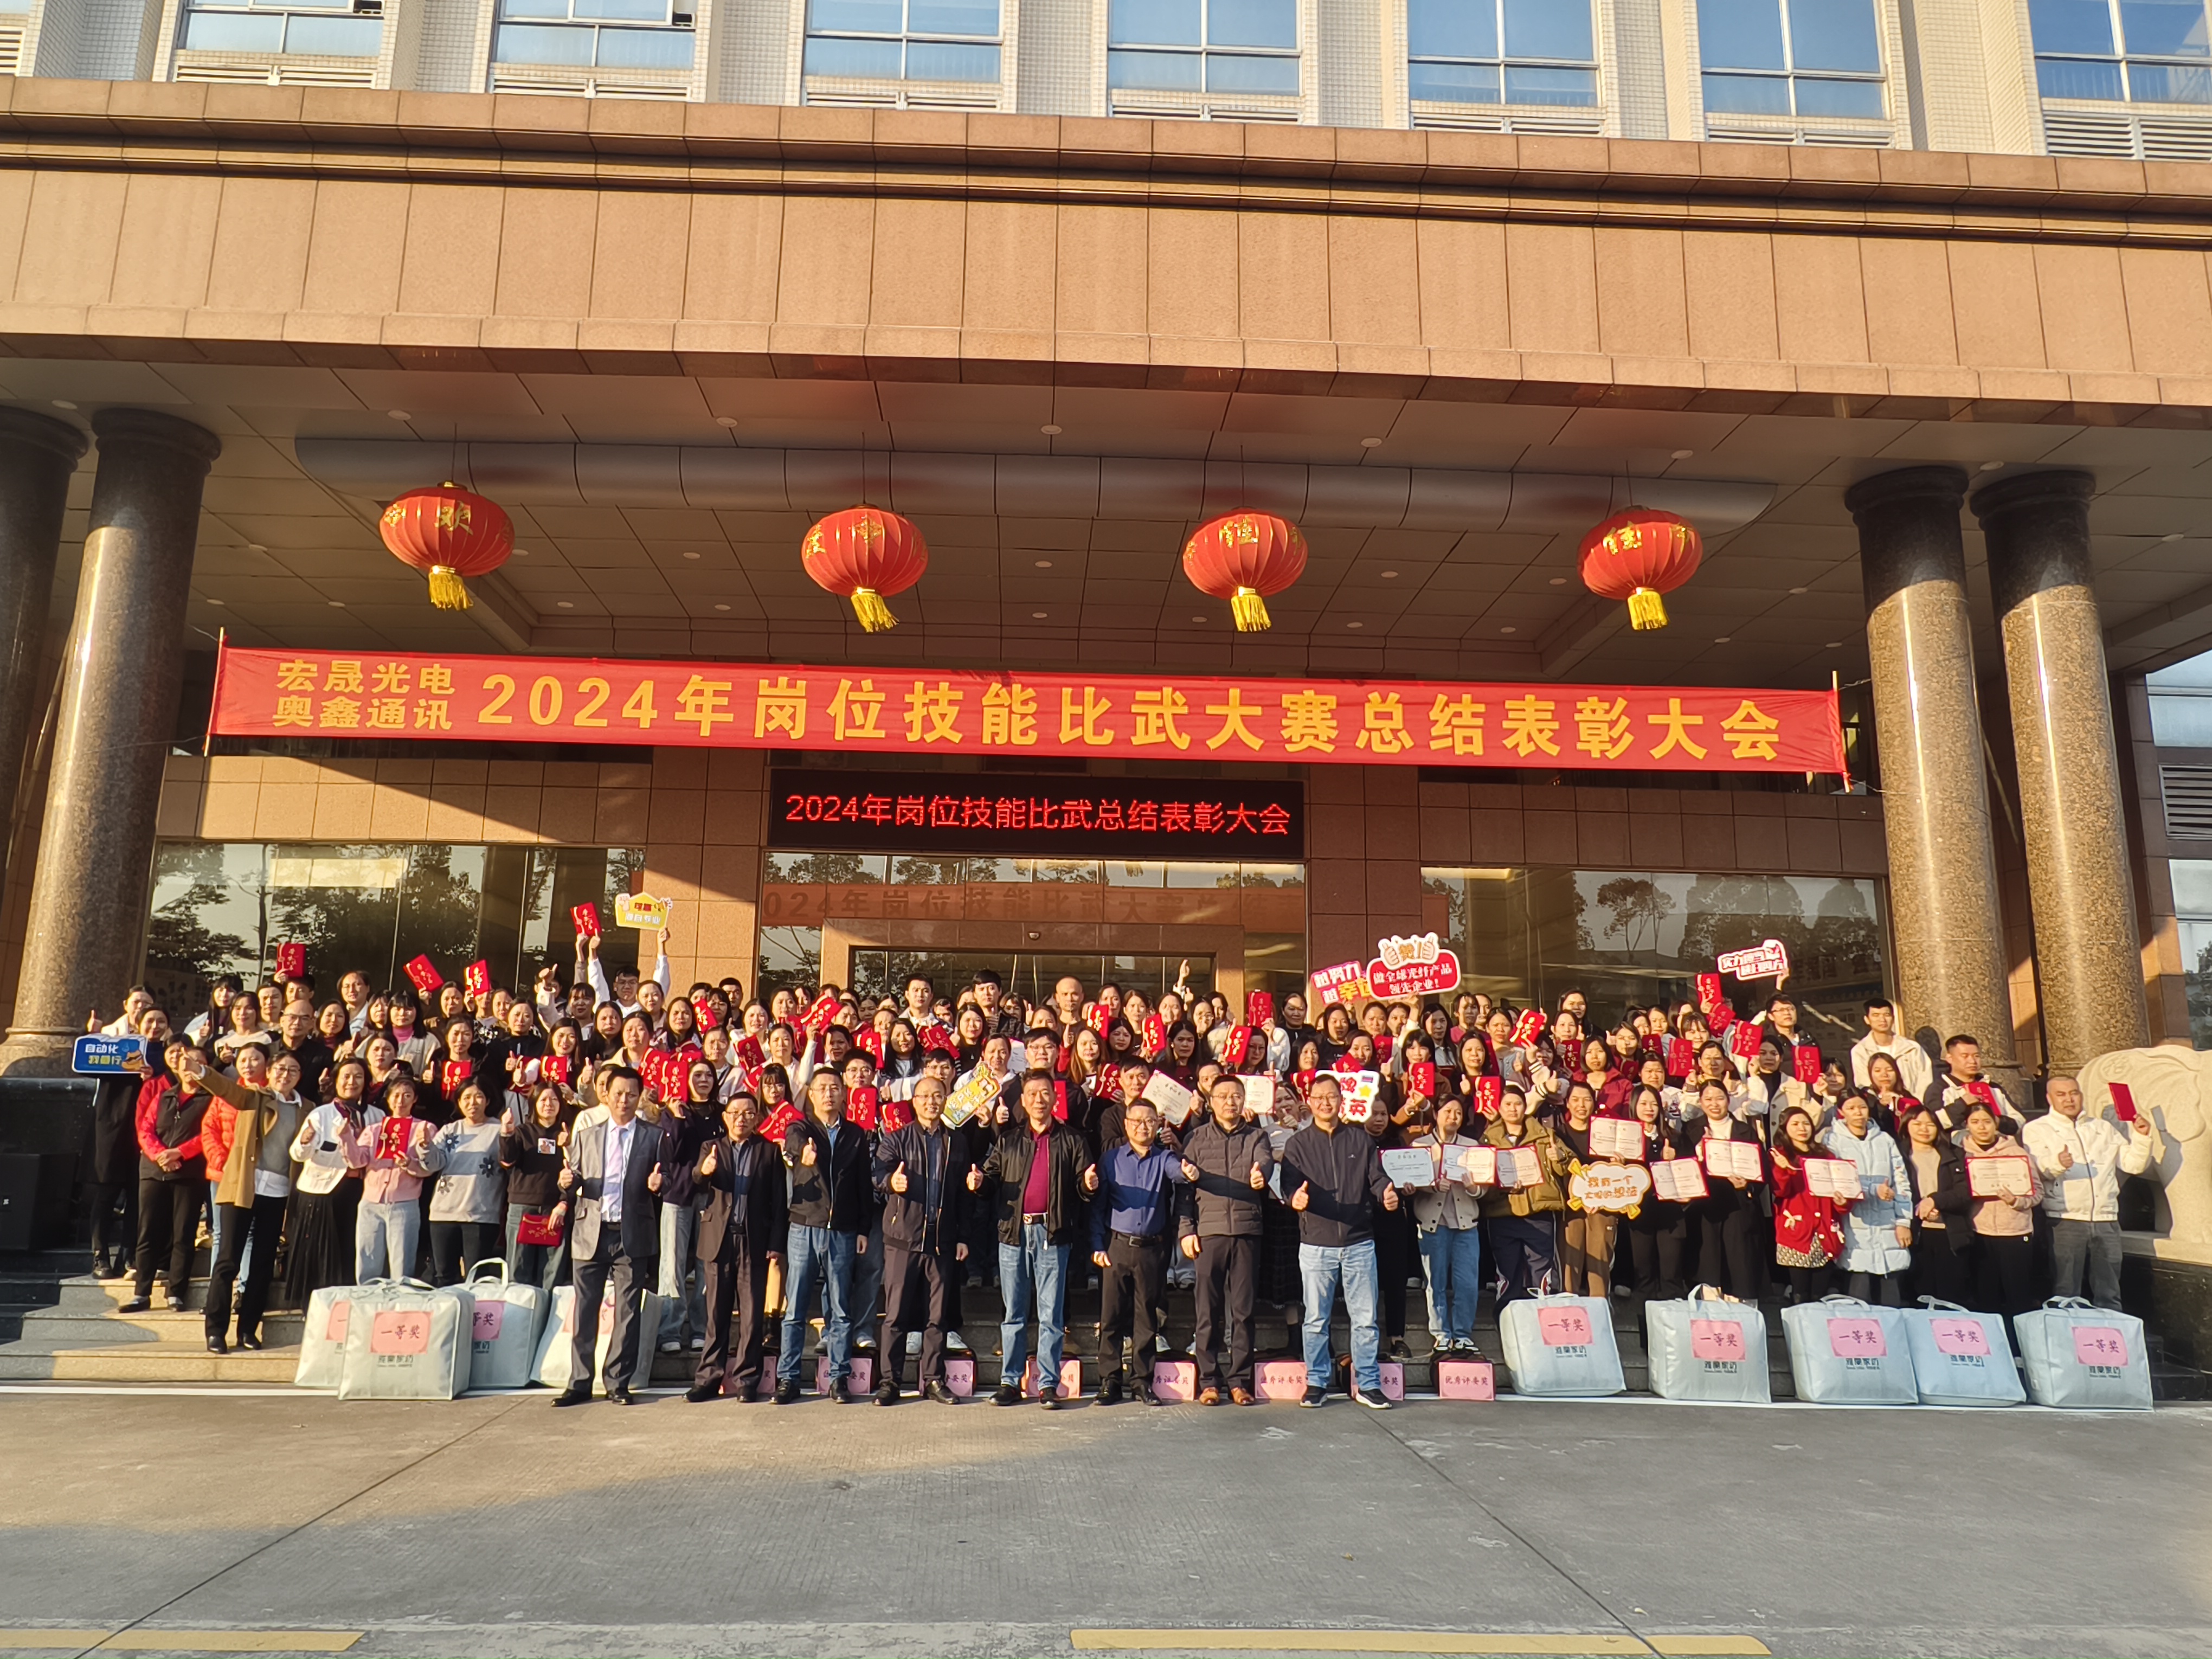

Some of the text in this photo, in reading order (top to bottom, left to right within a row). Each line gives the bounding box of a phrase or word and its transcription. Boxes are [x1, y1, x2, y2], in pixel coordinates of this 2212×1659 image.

[276, 659, 455, 695] 宏晟光电
[272, 695, 453, 730] 奥鑫通讯
[478, 674, 1779, 761] 2024年岗位技能比武大赛总结表彰大会
[786, 793, 1290, 835] 2024年岗位技能比武总结表彰大会
[85, 1044, 119, 1053] 自动化
[473, 1311, 494, 1326] 等奖
[1548, 1319, 1584, 1332] 一等奖
[381, 1324, 420, 1340] 一等奖
[1839, 1330, 1877, 1343] 一等奖
[1942, 1329, 1979, 1342] 一等奖
[1700, 1333, 1738, 1347] 一等奖
[2083, 1339, 2119, 1353] 一等奖
[1445, 1375, 1488, 1386] 优秀评委奖
